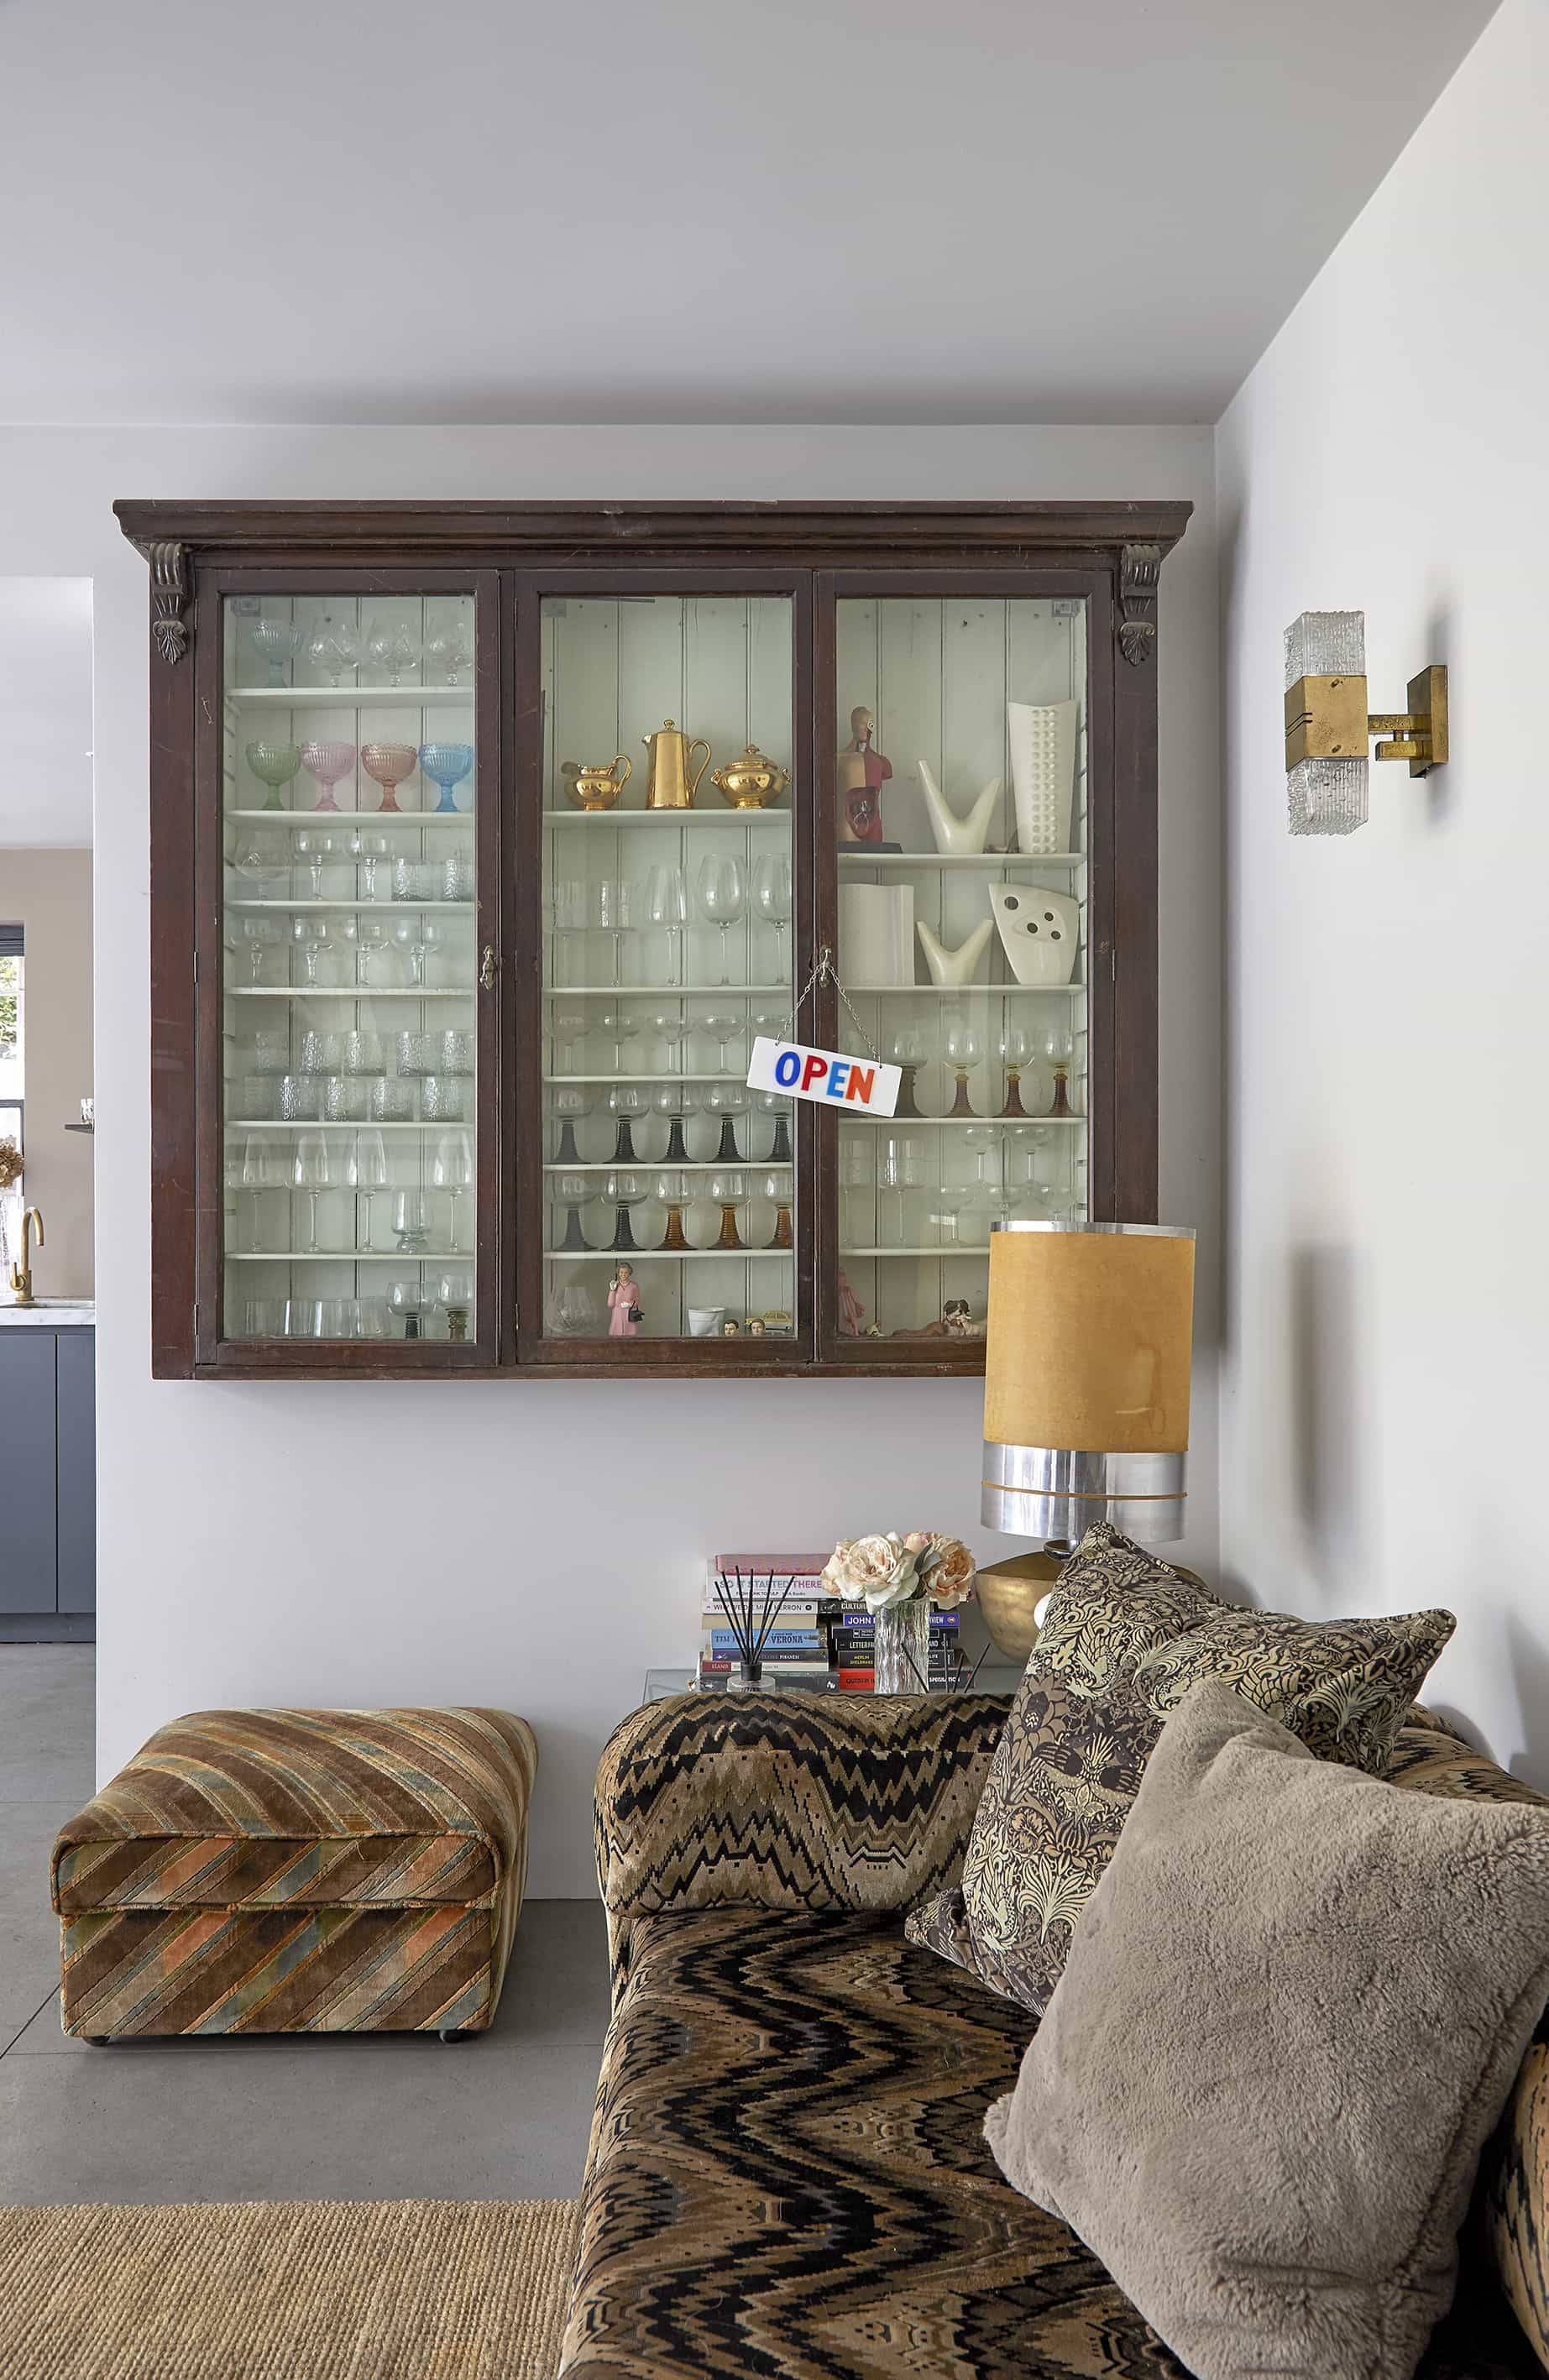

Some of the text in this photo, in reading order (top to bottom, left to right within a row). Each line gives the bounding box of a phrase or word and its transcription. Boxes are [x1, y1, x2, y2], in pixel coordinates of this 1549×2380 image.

[774, 1051, 875, 1104] OPEN
[793, 1580, 822, 1588] THERE
[771, 1635, 803, 1644] VERONA
